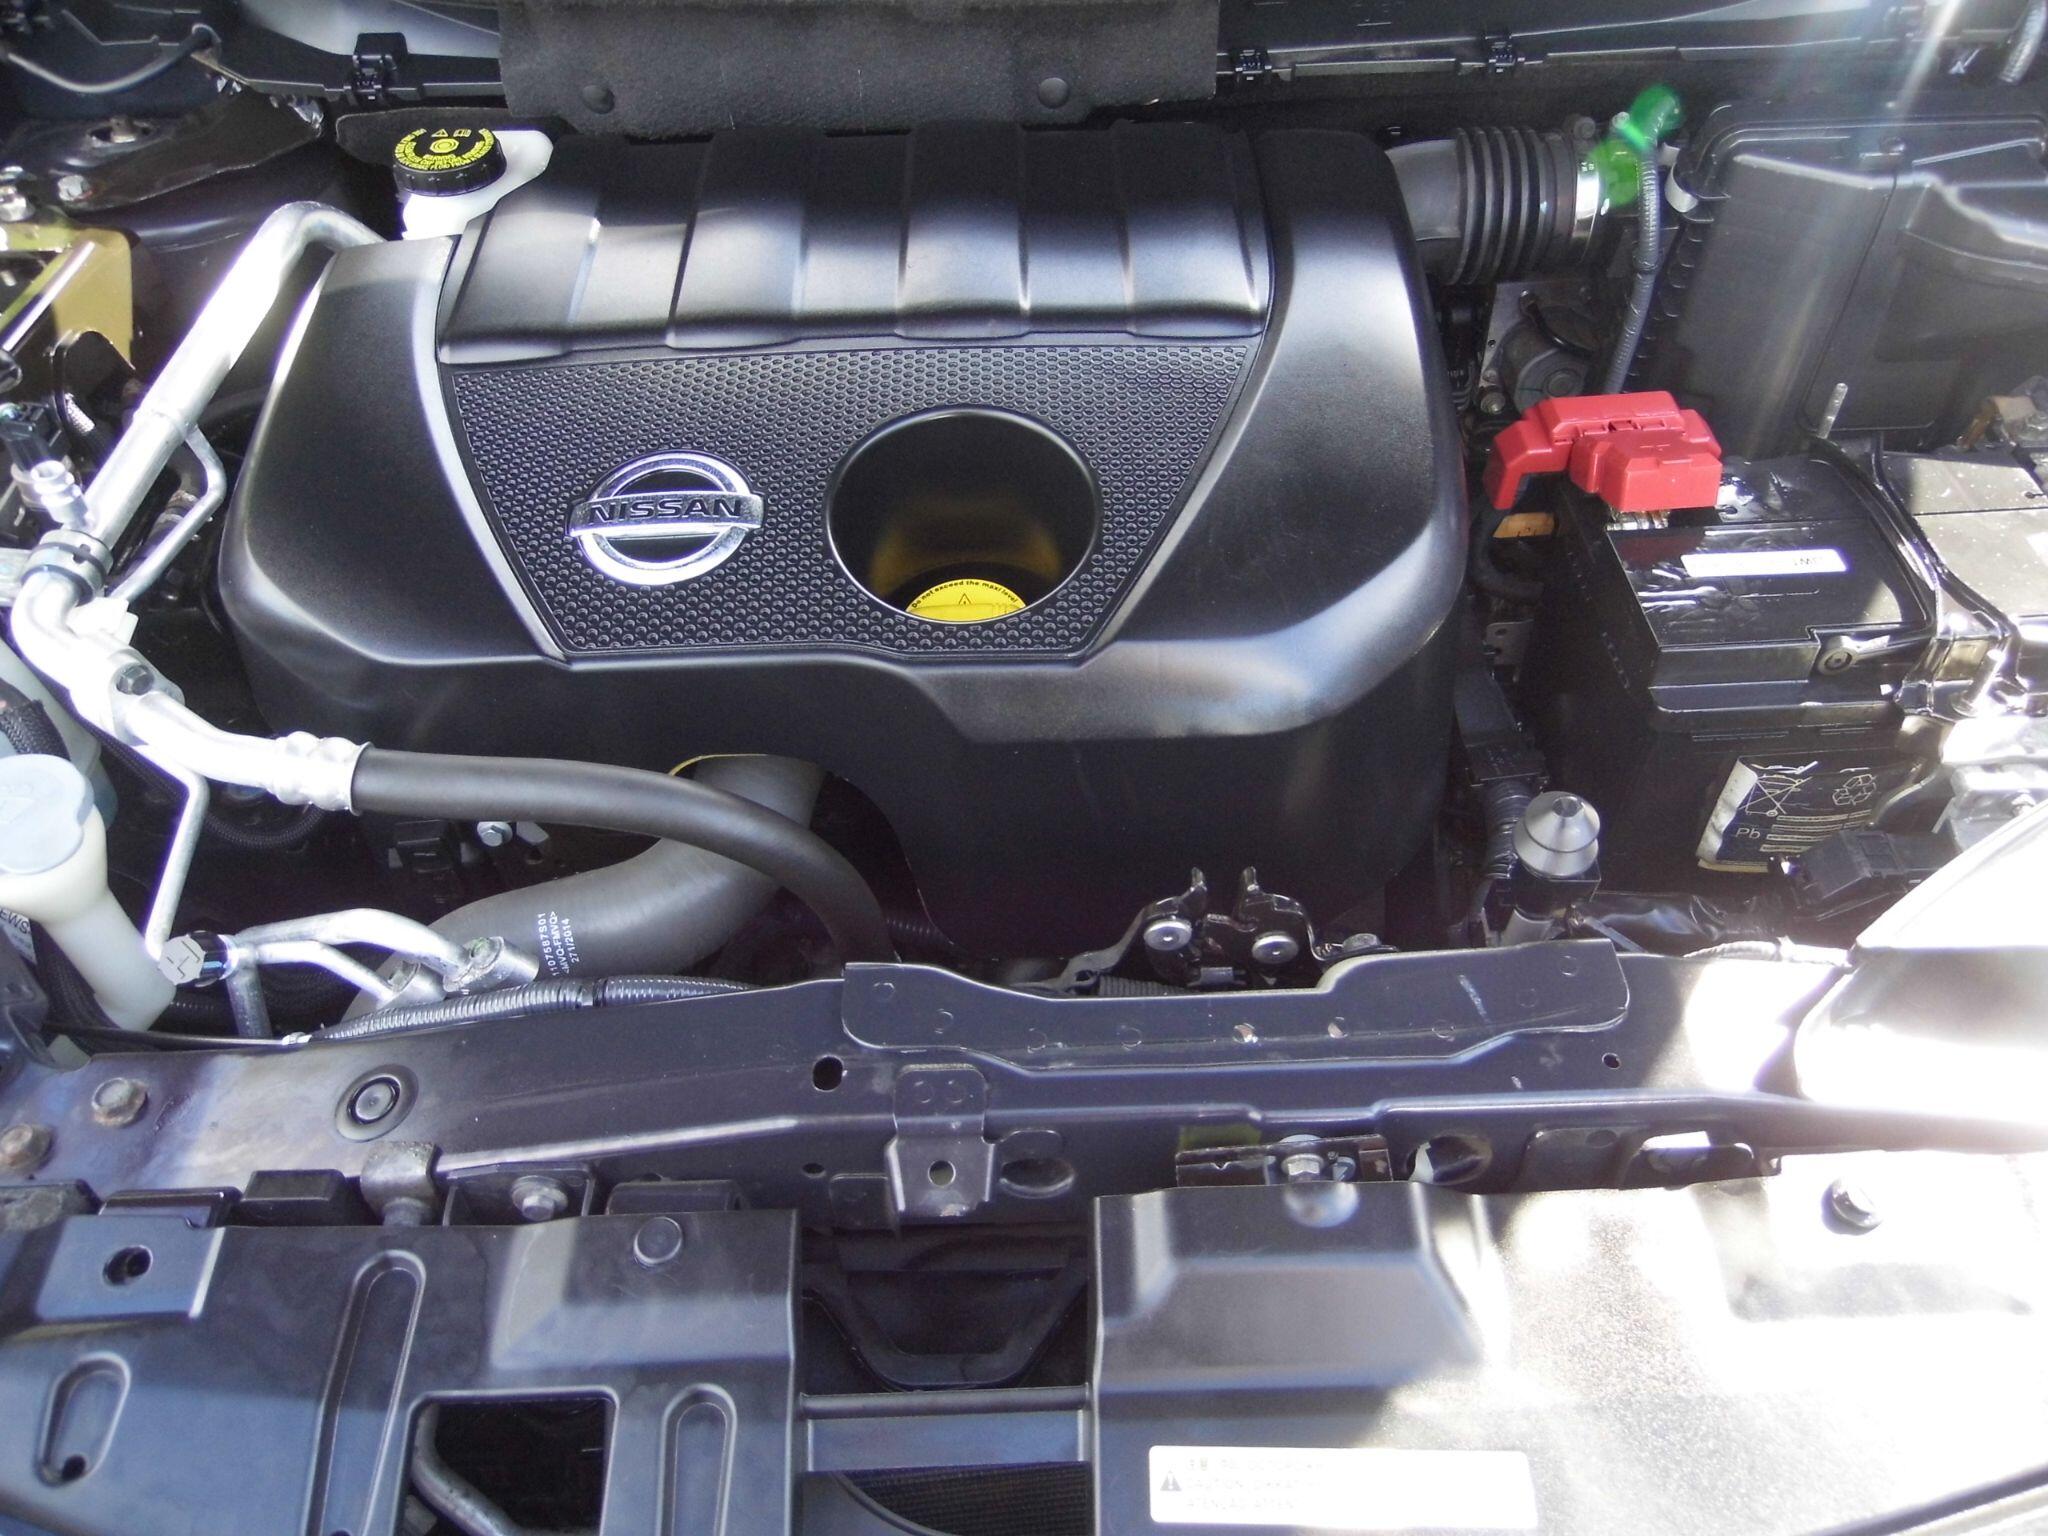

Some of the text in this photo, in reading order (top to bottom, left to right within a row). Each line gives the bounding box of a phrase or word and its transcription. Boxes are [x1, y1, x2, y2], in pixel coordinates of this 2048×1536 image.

[588, 498, 742, 523] NISSAN
[922, 590, 933, 600] not
[934, 580, 964, 592] exceed
[1001, 589, 1018, 603] level
[1735, 826, 1761, 840] Pb
[561, 918, 580, 963] 271/2014
